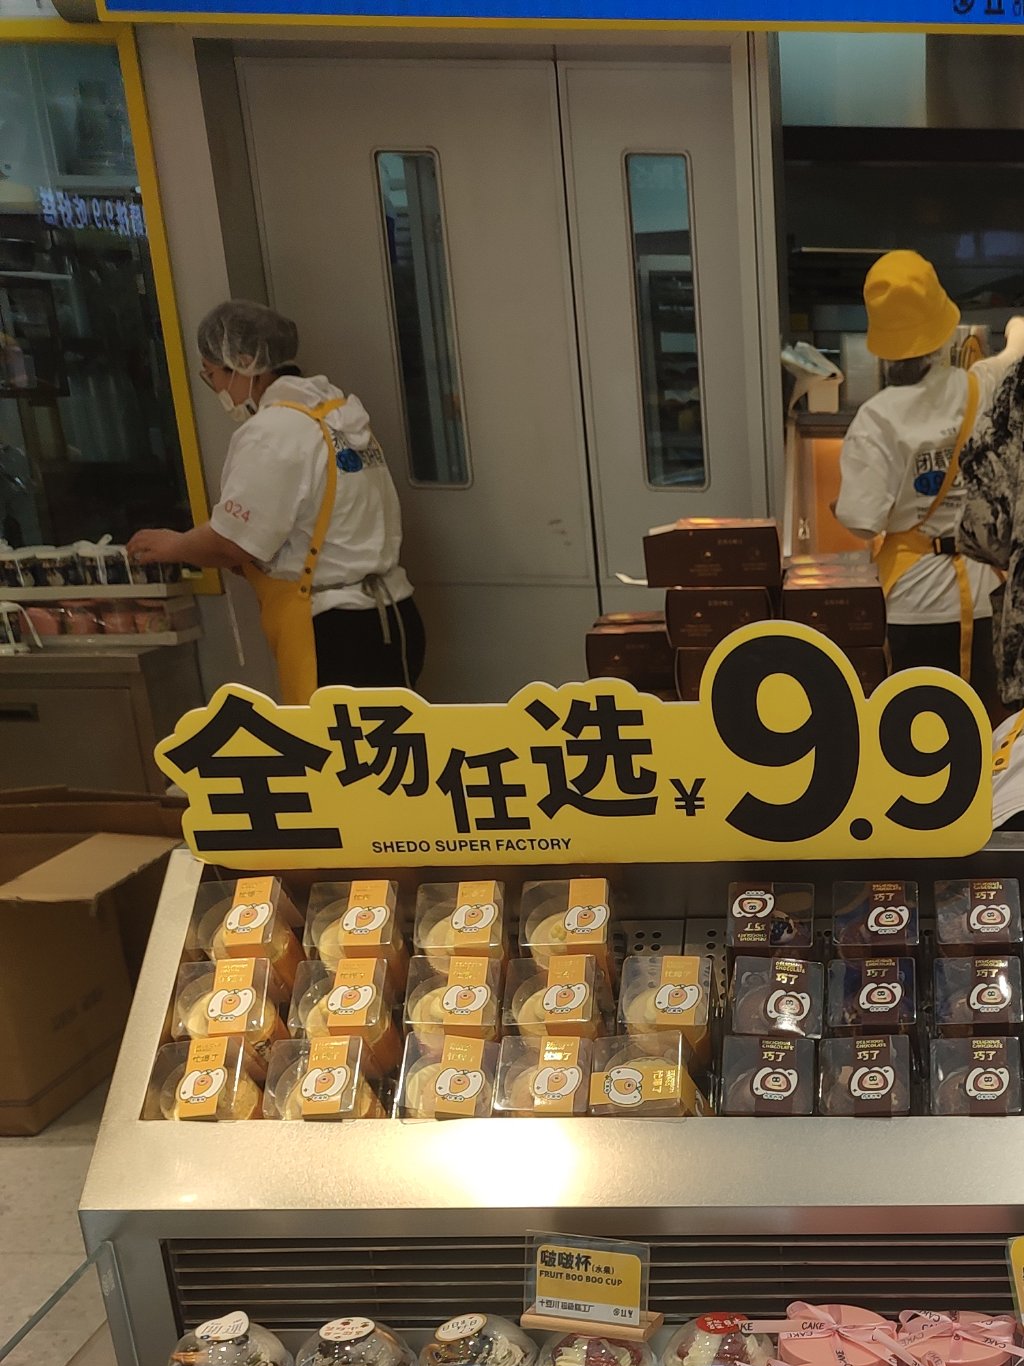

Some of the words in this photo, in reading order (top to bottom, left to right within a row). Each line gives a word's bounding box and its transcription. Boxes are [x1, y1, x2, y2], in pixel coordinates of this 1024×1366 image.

[224, 500, 250, 523] 024
[166, 693, 658, 853] 全场任选
[371, 840, 431, 854] SHEDO
[435, 839, 491, 853] SUPER
[495, 837, 572, 851] FACTORY
[539, 1270, 563, 1279] FRUIT
[566, 1273, 583, 1282] BOO
[586, 1276, 603, 1284] BOO
[605, 1278, 622, 1286] CUP
[801, 1321, 825, 1331] CAKE
[982, 1336, 1007, 1350] CAKE
